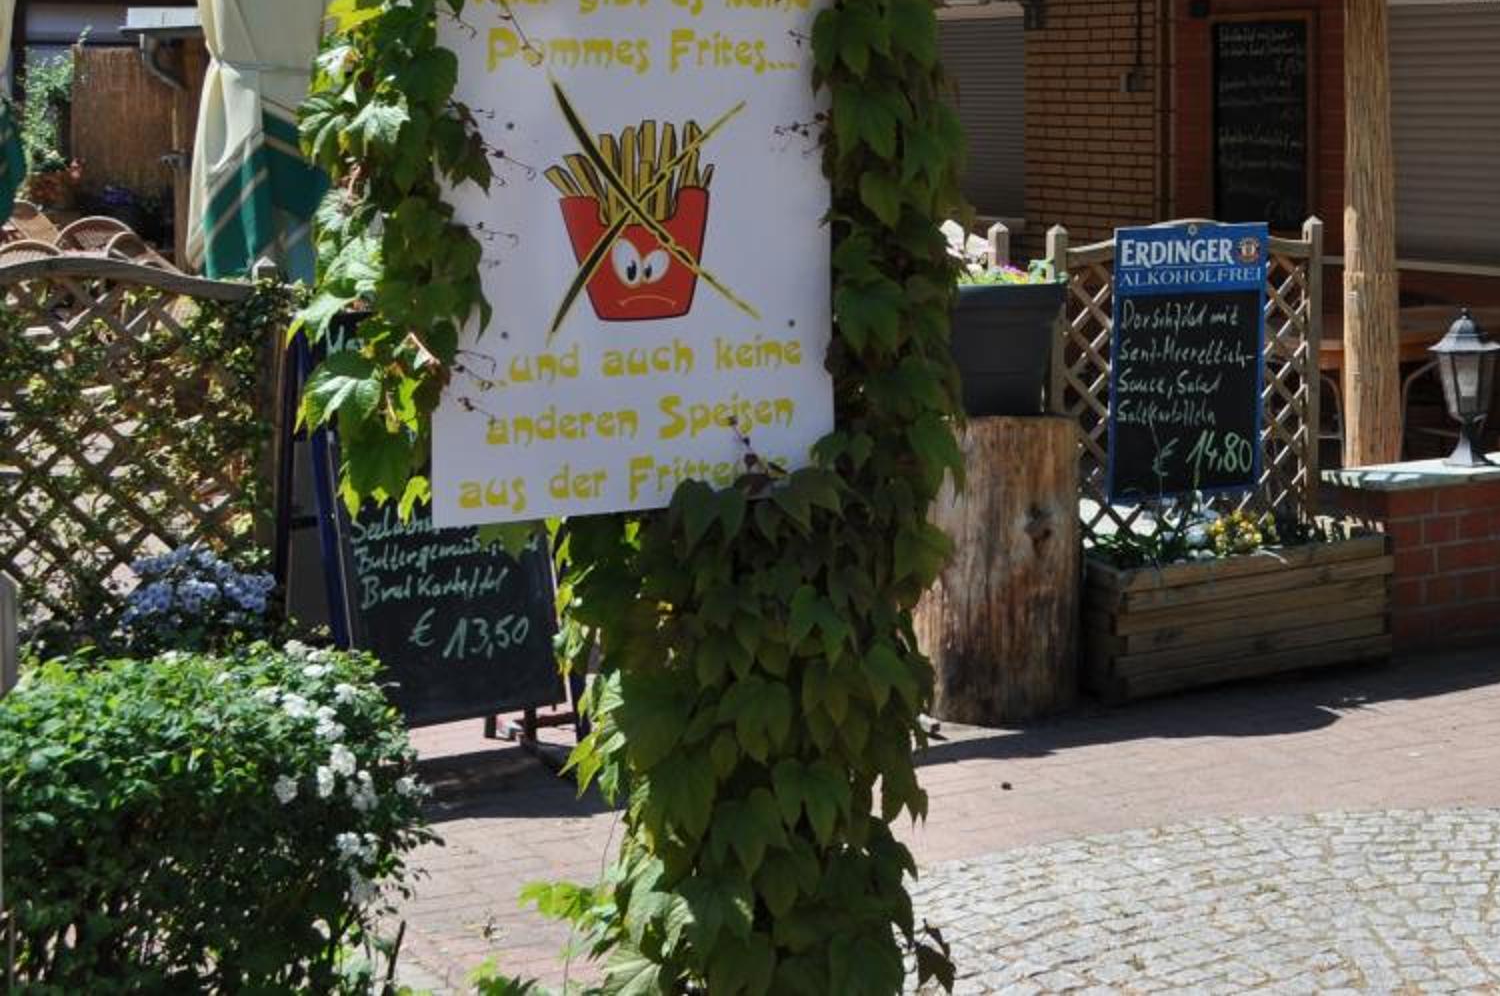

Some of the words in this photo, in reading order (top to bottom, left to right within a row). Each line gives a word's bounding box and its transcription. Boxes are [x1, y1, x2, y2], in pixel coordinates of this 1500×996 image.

[486, 27, 649, 75] Pommes
[670, 27, 799, 75] Frites...
[1119, 267, 1262, 287] ALKOHOLFREI
[1120, 239, 1235, 269] ERDINGER
[602, 336, 695, 379] auch
[714, 334, 802, 373] keine
[486, 404, 640, 448] anderen
[658, 391, 795, 440] Speisen
[1186, 428, 1253, 474] 14,80
[459, 475, 527, 515] aus
[549, 463, 608, 500] der
[408, 607, 437, 647] €
[442, 614, 530, 659] 13,50
